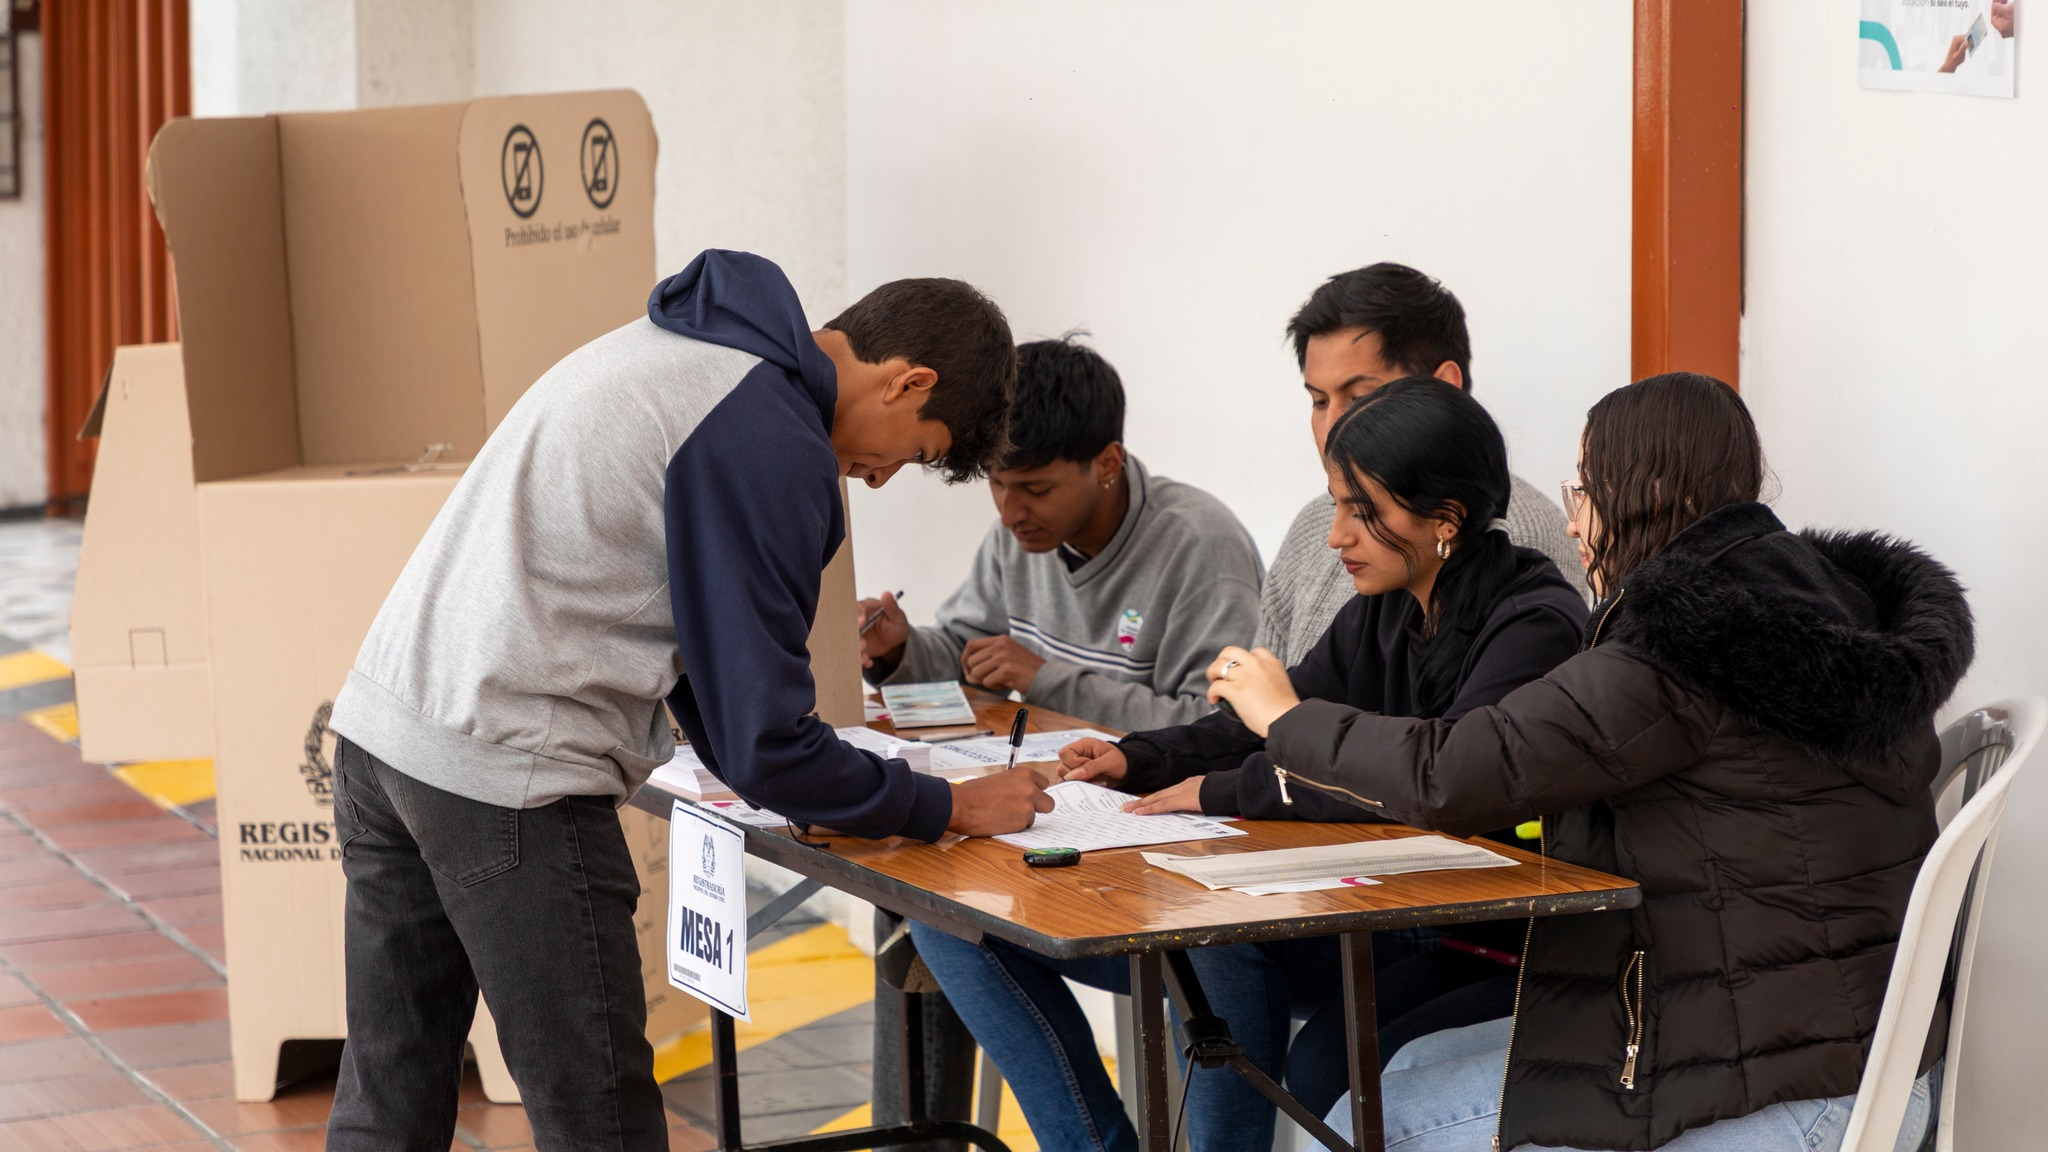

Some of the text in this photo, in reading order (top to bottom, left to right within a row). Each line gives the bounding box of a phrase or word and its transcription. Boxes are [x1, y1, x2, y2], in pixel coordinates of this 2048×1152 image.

[504, 224, 551, 248] Prohibido
[553, 220, 562, 242] el
[564, 224, 578, 240] uso
[592, 215, 621, 236] celular
[239, 822, 337, 845] REGIS
[240, 848, 323, 862] NACIONAL
[680, 905, 734, 975] MESA 1
